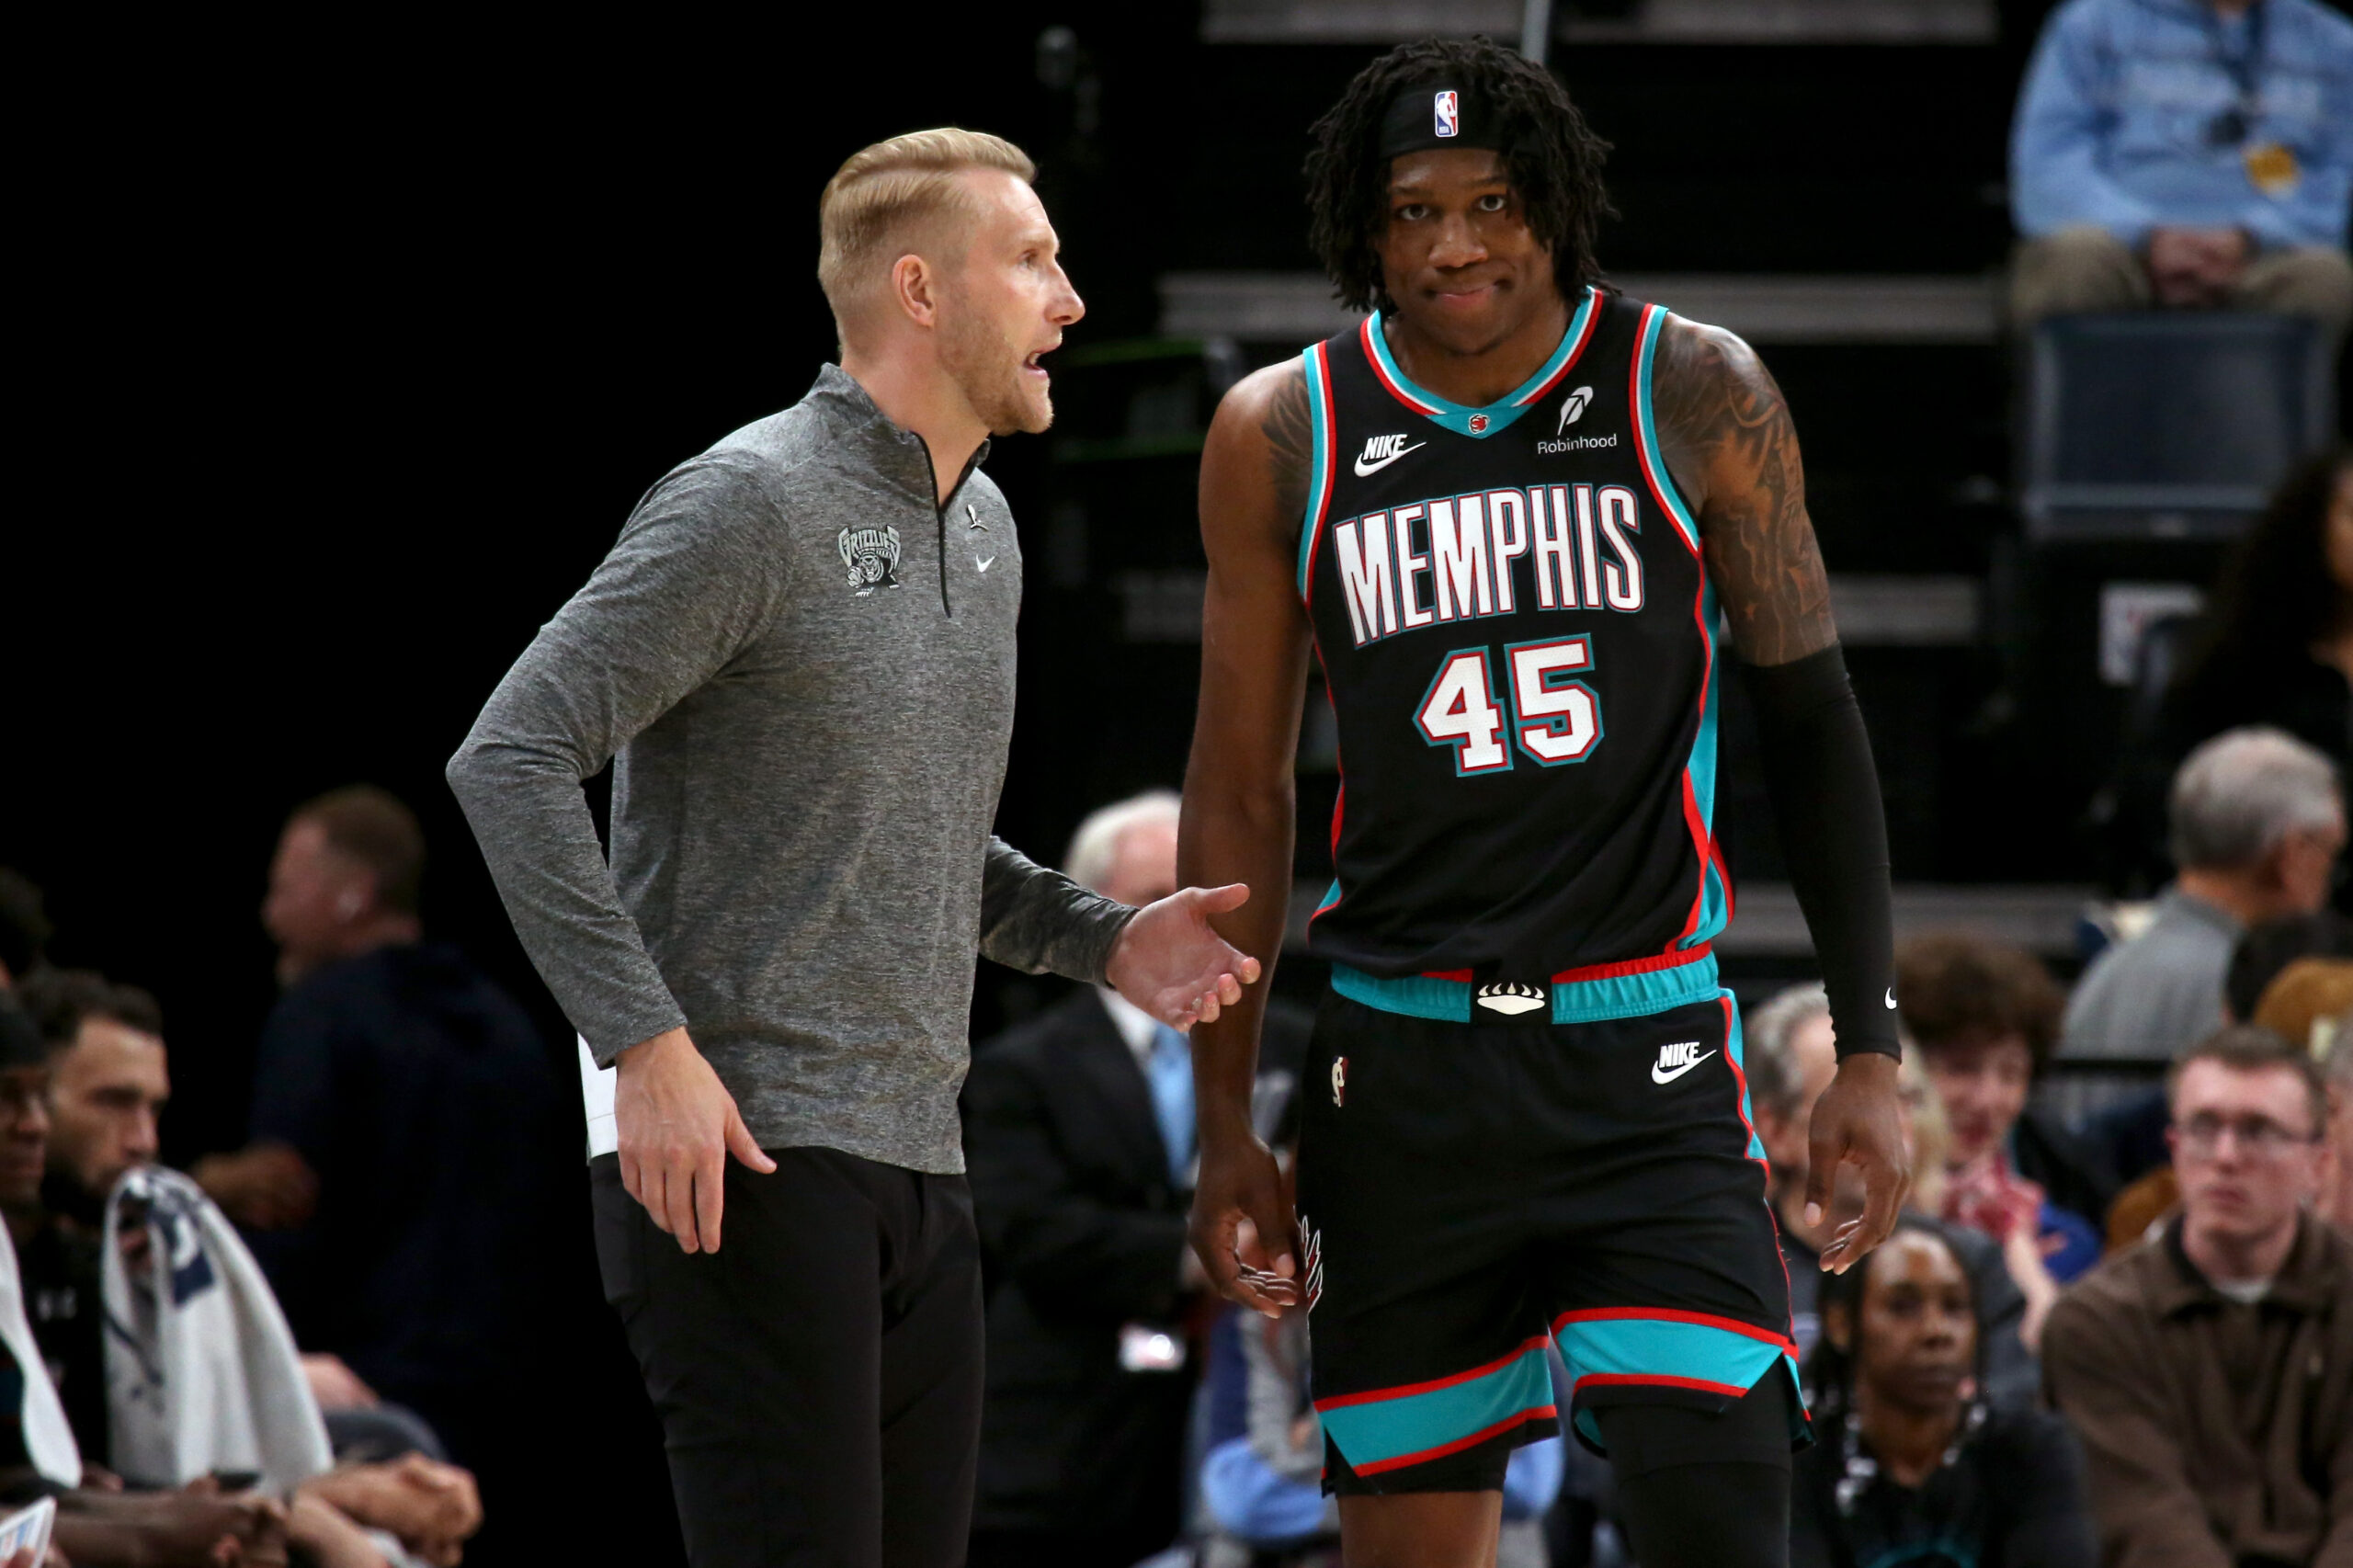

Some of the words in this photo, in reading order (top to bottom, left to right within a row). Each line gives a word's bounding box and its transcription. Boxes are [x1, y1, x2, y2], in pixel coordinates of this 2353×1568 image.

[1363, 434, 1407, 460] NIKE
[1537, 433, 1618, 454] Robinhood
[1332, 483, 1645, 650] MEMPHIS
[1412, 632, 1605, 778] 45
[1658, 1041, 1700, 1068] NIKE
